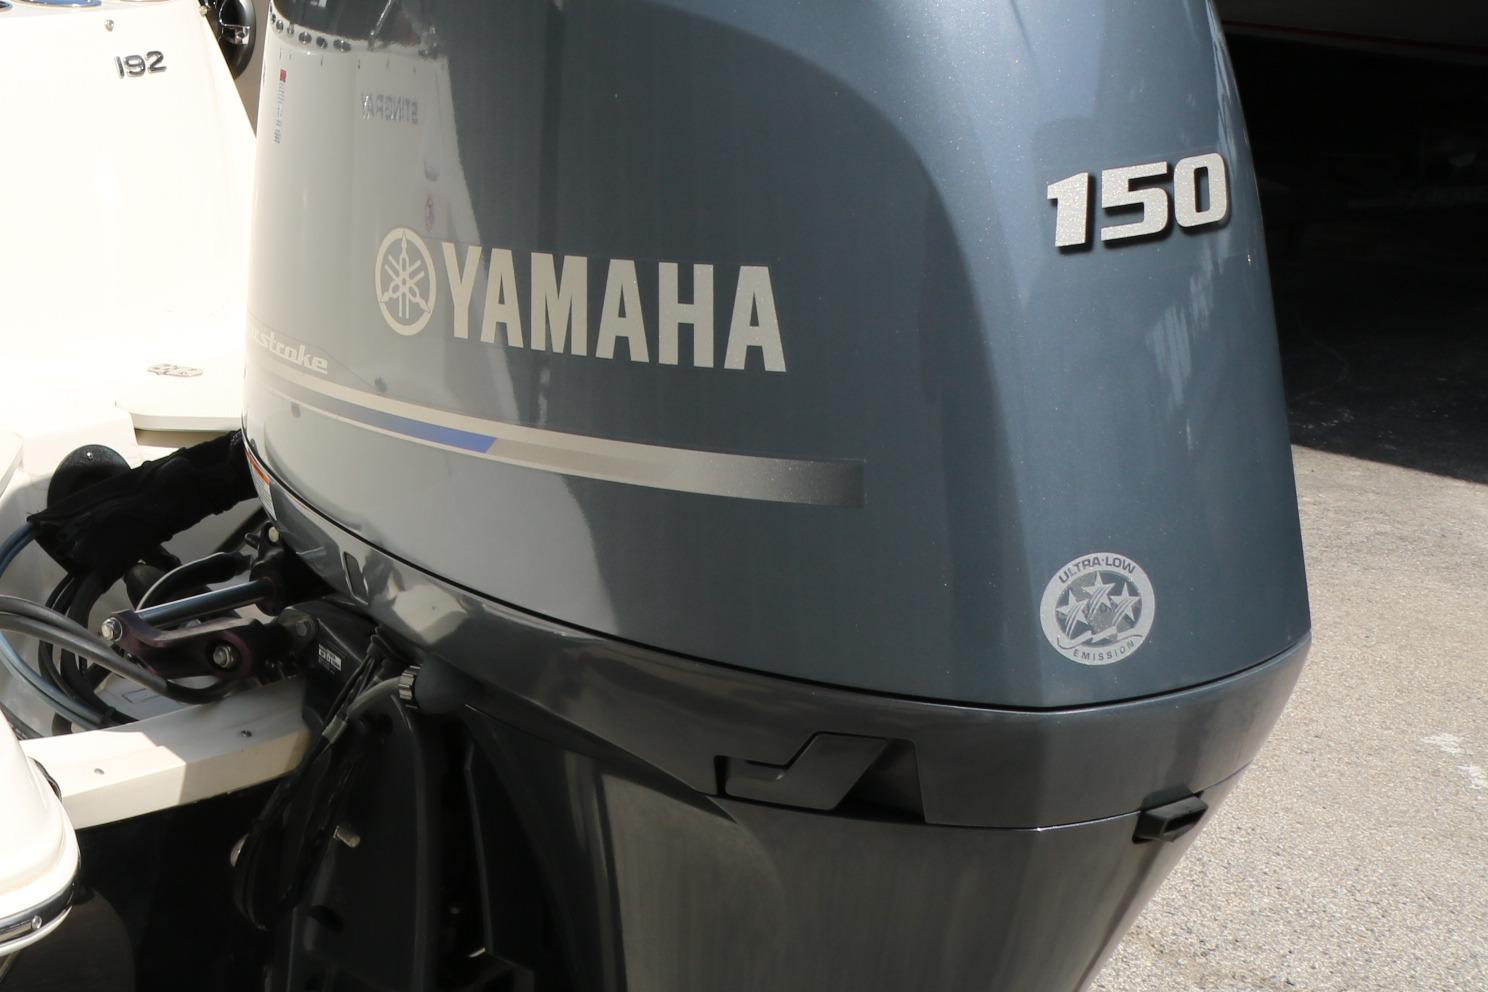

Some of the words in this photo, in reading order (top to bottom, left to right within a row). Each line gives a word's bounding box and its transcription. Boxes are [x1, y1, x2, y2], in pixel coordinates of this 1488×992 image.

[114, 50, 168, 80] 192
[1047, 152, 1229, 248] 150
[441, 241, 787, 373] YAMAHA
[252, 327, 329, 375] stroke
[1072, 638, 1136, 662] EMISSION
